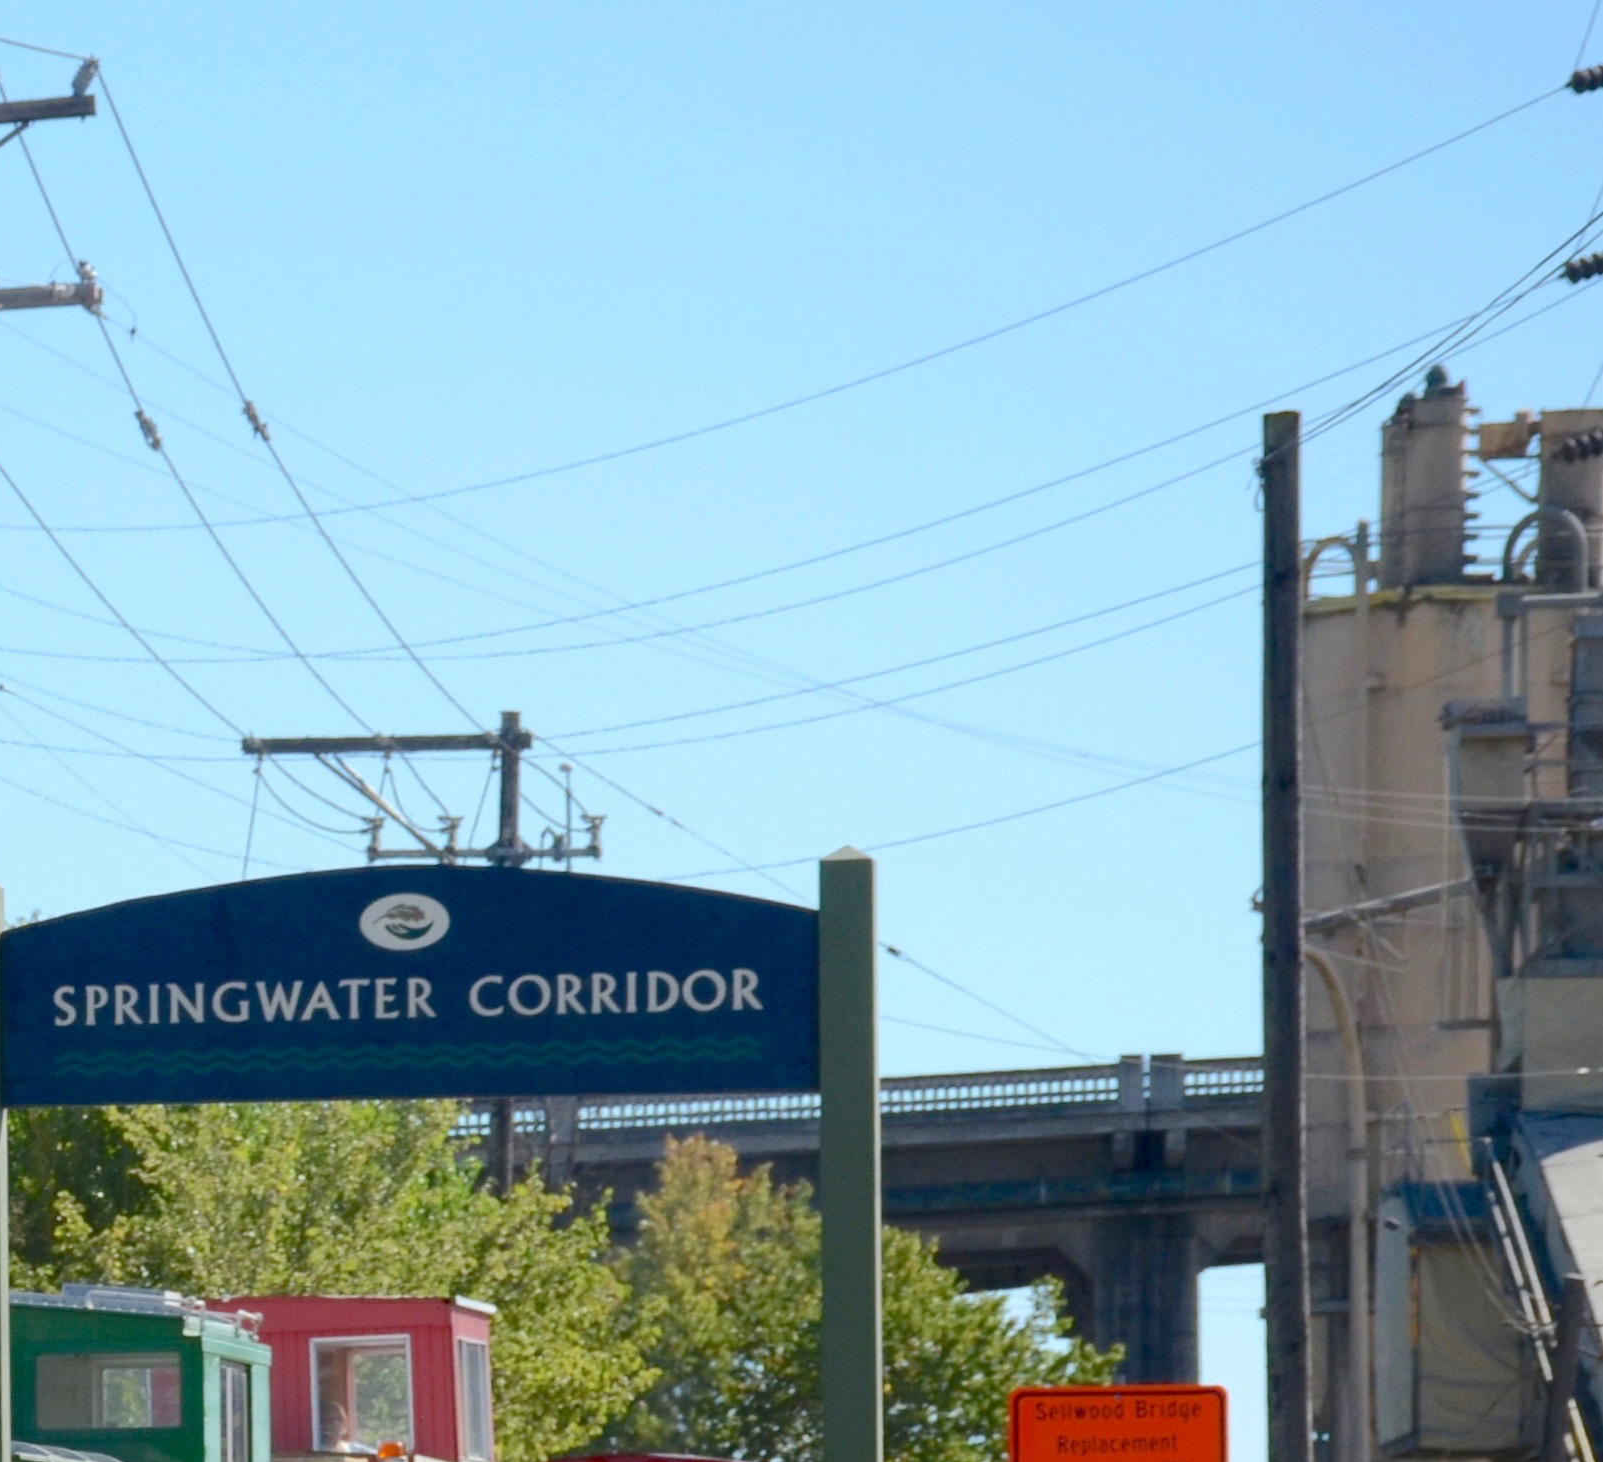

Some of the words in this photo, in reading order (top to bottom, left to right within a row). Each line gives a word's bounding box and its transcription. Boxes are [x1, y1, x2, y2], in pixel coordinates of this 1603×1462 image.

[53, 977, 436, 1027] SPRINGWATER
[469, 967, 764, 1018] CORRIDOR
[1035, 1402, 1125, 1421] Sellwood
[1135, 1400, 1203, 1423] Bridge
[1056, 1434, 1178, 1456] Replacement
